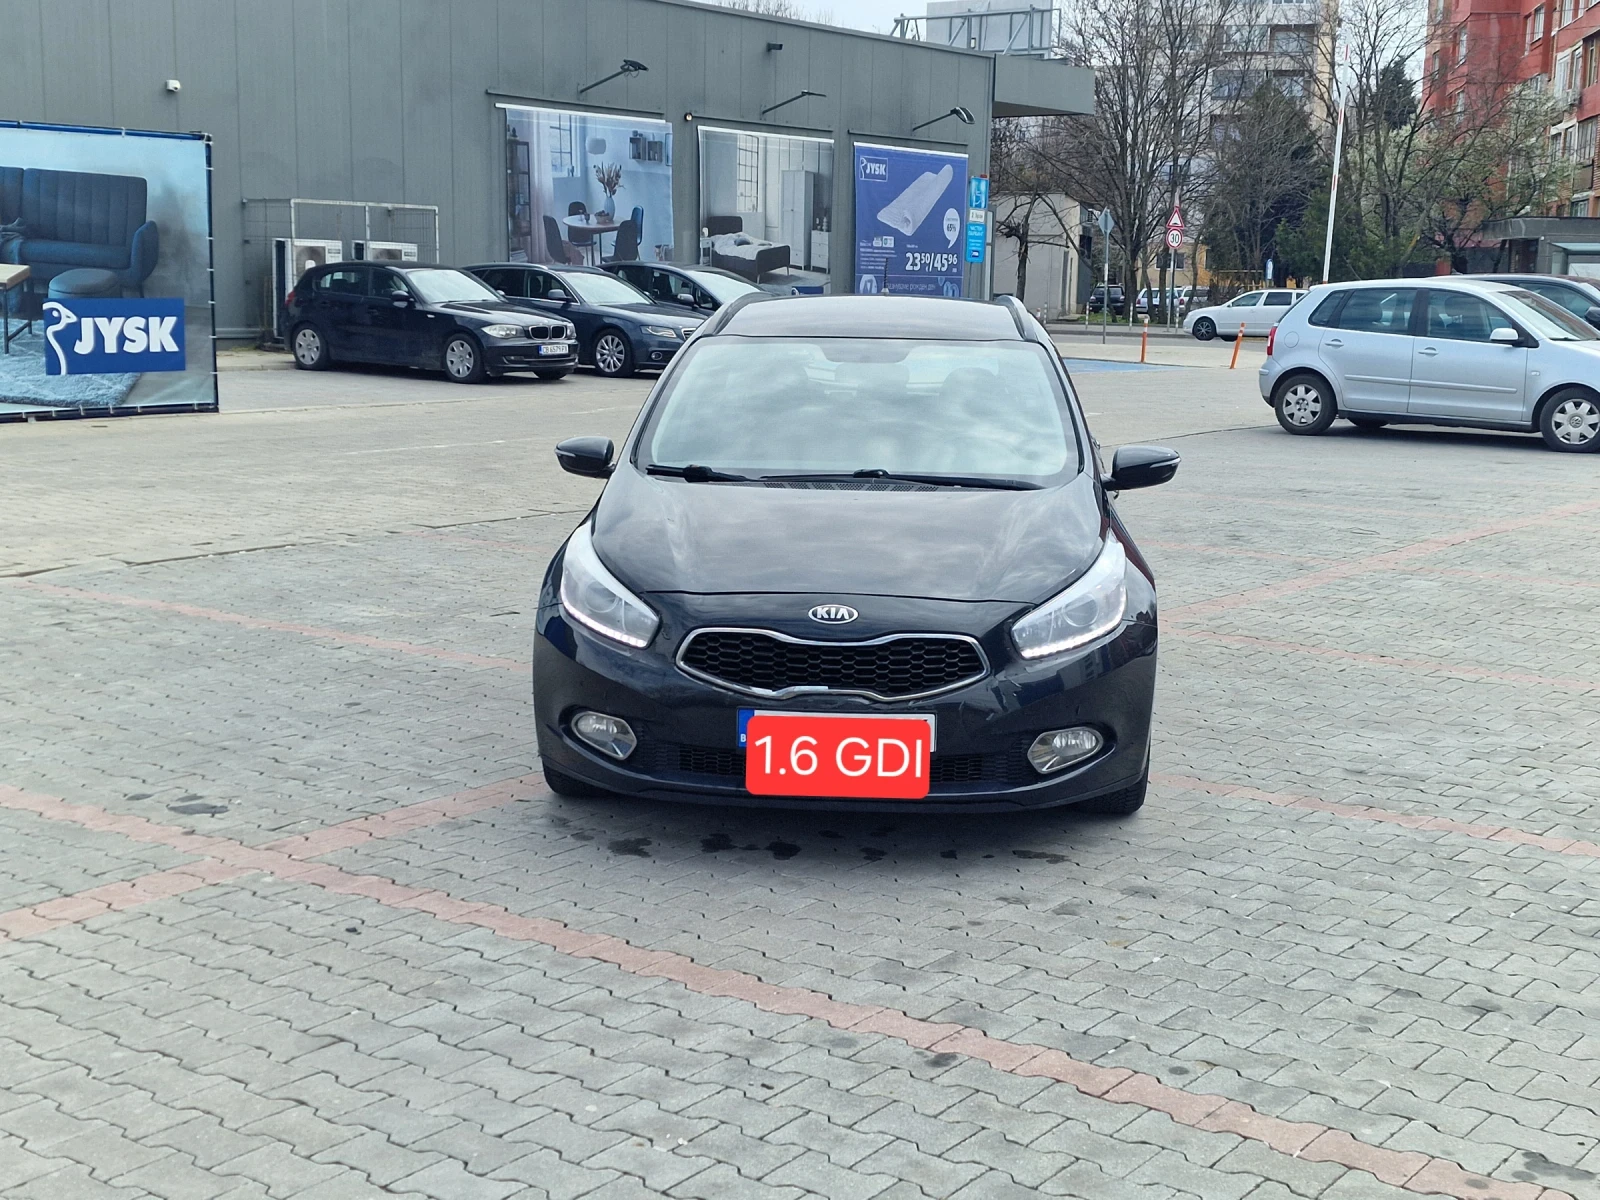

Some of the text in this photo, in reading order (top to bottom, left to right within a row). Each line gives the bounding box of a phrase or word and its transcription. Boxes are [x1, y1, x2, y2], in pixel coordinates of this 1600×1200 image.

[866, 163, 886, 175] JYSK
[1170, 233, 1179, 244] 30
[73, 316, 180, 355] JYSK
[815, 607, 850, 619] KIA
